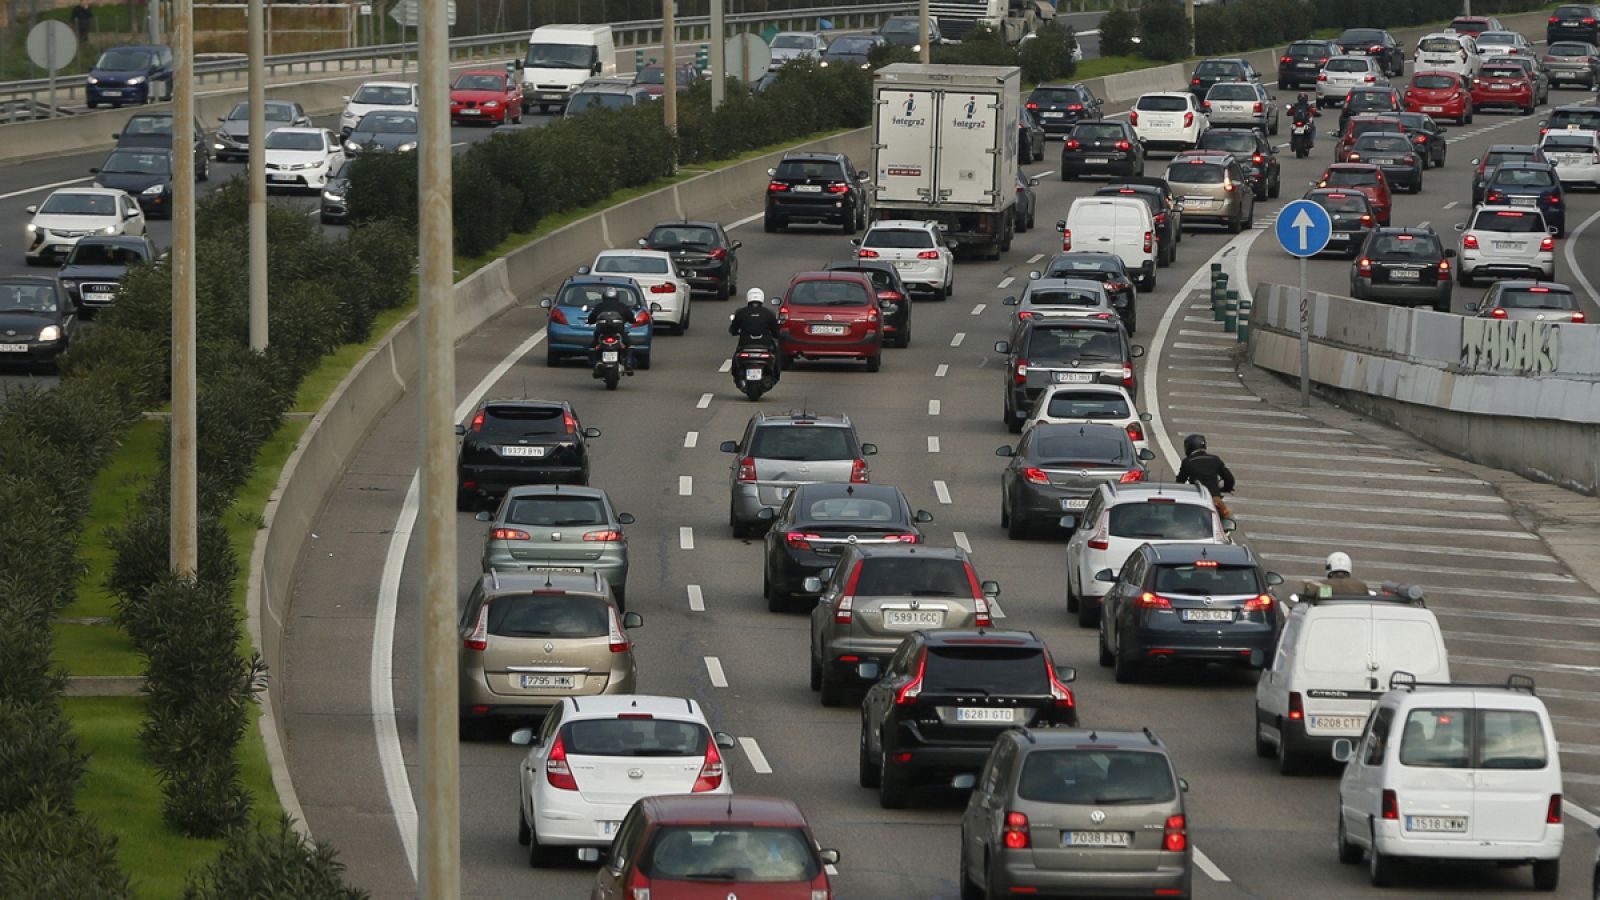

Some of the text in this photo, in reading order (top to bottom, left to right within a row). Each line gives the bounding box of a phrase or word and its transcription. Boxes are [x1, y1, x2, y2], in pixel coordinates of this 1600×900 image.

[894, 612, 917, 622] 5991
[527, 676, 550, 686] 7795
[964, 708, 988, 720] 6281
[1317, 718, 1361, 728] 6208 CTT
[1416, 819, 1440, 829] 1518
[1072, 832, 1101, 844] 7038
